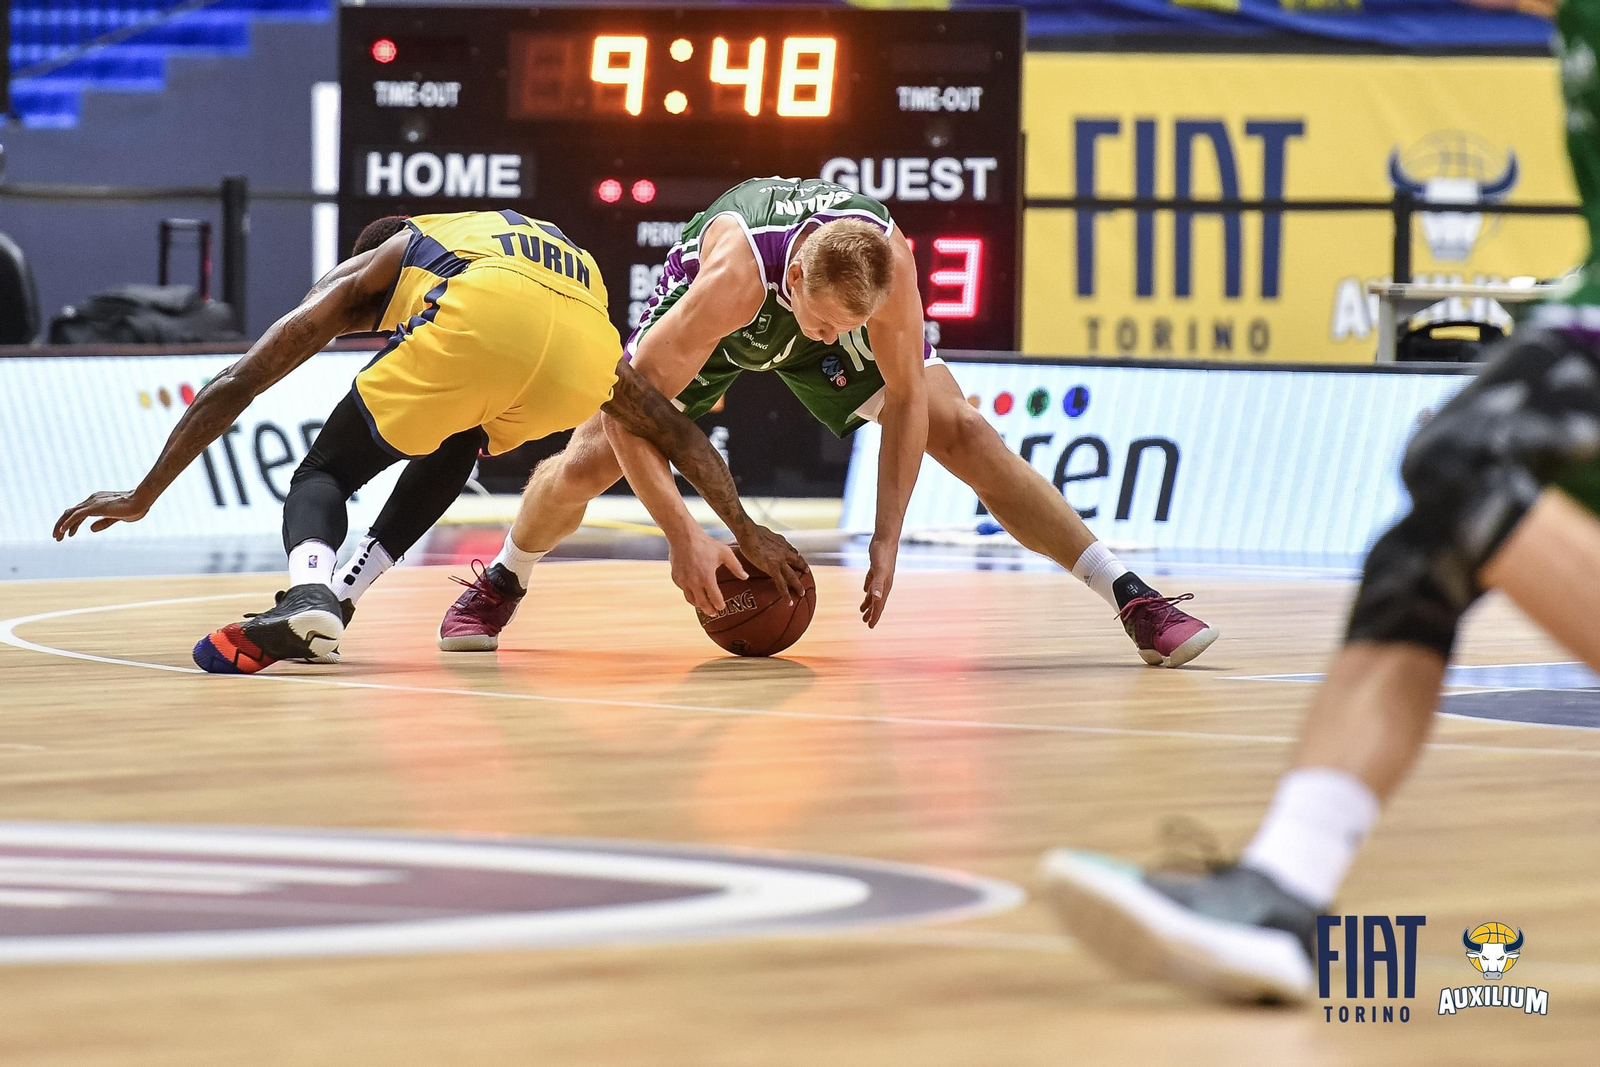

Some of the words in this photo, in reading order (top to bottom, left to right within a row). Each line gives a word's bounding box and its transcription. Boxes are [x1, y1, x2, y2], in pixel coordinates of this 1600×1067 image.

[590, 35, 838, 117] 9:48
[366, 151, 522, 198] HOME
[820, 157, 998, 201] GUEST
[1074, 119, 1306, 298] FIAT
[491, 232, 590, 290] TURIN
[905, 238, 982, 318] 3
[1087, 317, 1271, 353] TORINO
